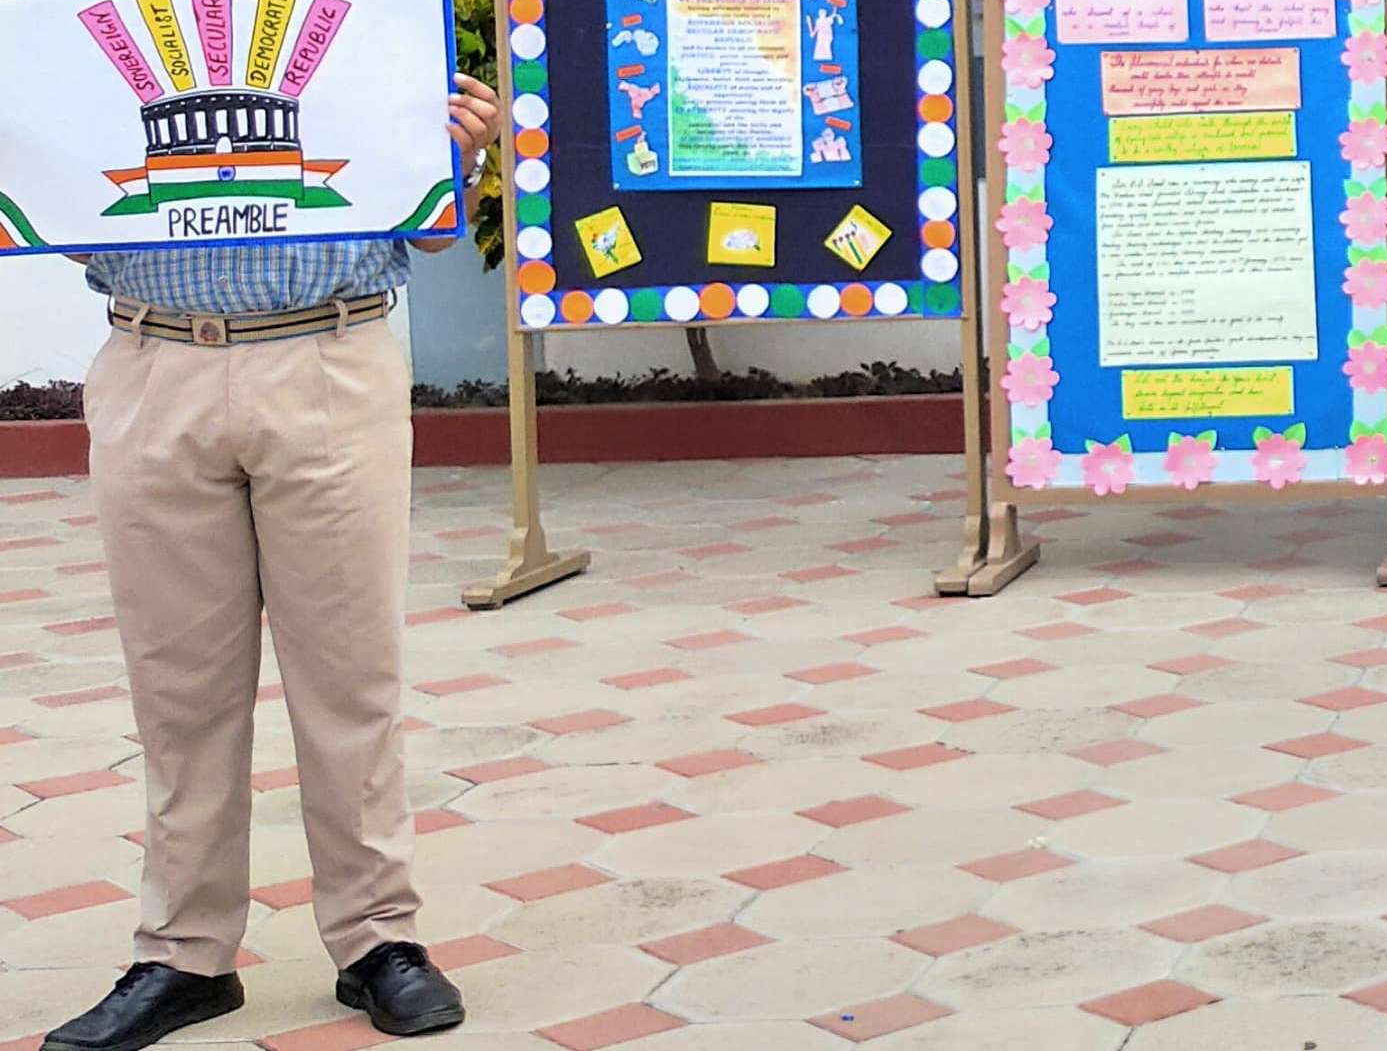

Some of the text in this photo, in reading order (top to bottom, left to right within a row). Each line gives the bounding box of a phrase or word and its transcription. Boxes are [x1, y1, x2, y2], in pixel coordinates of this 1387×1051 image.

[89, 9, 156, 93] SOVEREIGN
[150, 4, 189, 77] SOCIALIST
[283, 6, 338, 87] REPUBLIC
[168, 202, 289, 239] PREAMBLE
